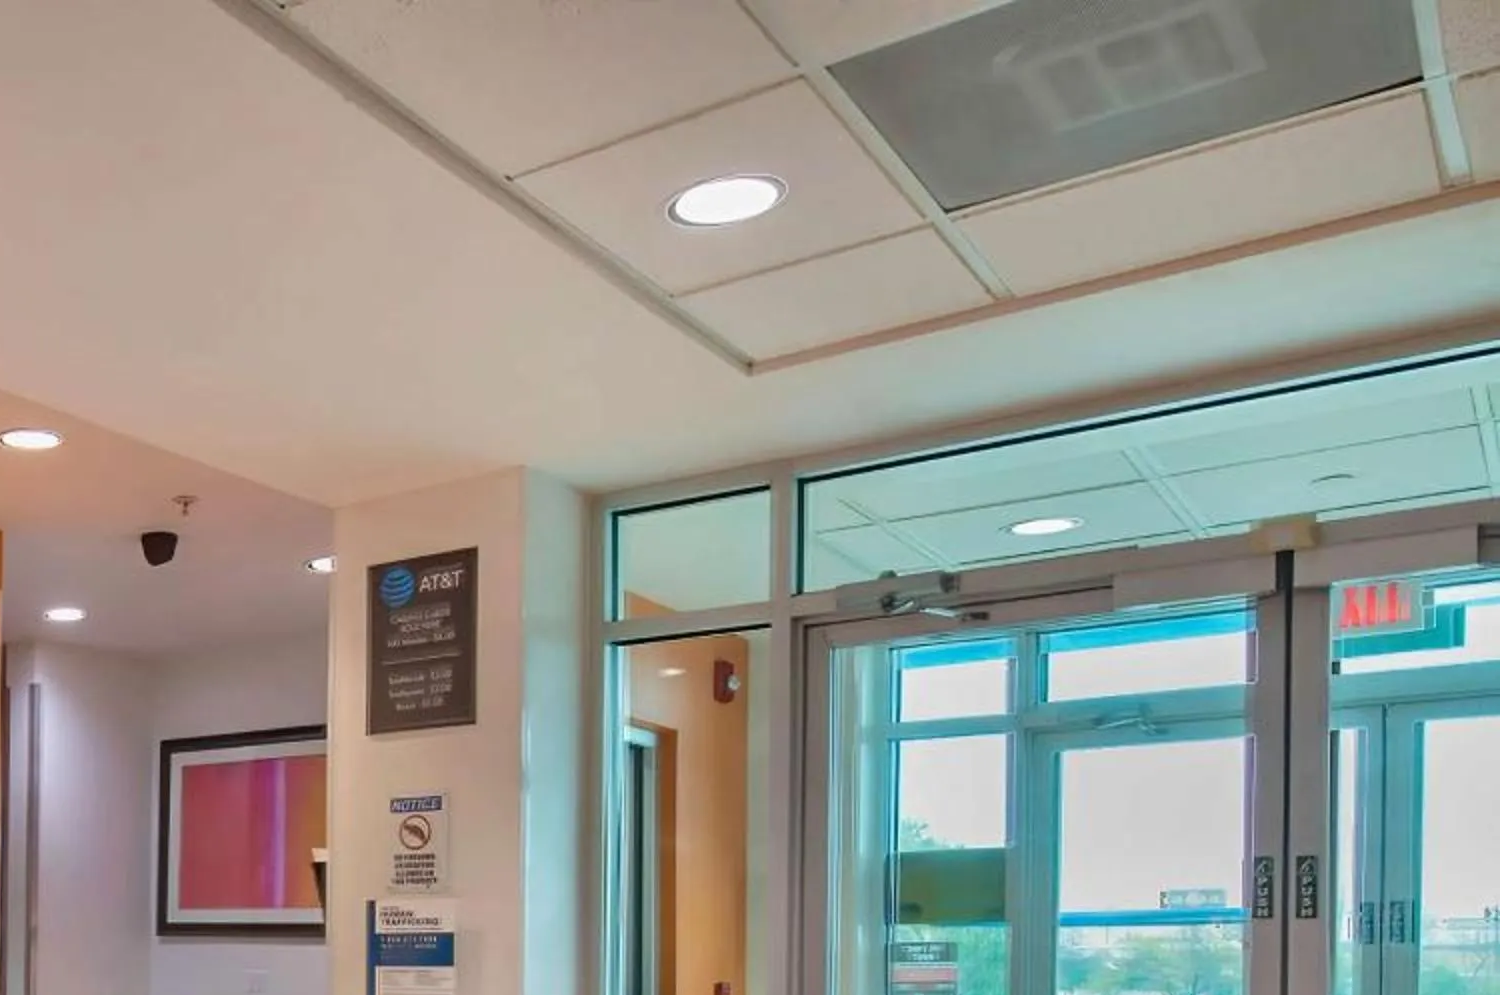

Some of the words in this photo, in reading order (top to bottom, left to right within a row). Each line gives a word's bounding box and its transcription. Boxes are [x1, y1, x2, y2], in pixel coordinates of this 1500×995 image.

[419, 569, 465, 593] AT&T
[392, 798, 439, 811] NOTICE
[1256, 875, 1269, 917] PUSH
[1300, 875, 1314, 917] PUSH
